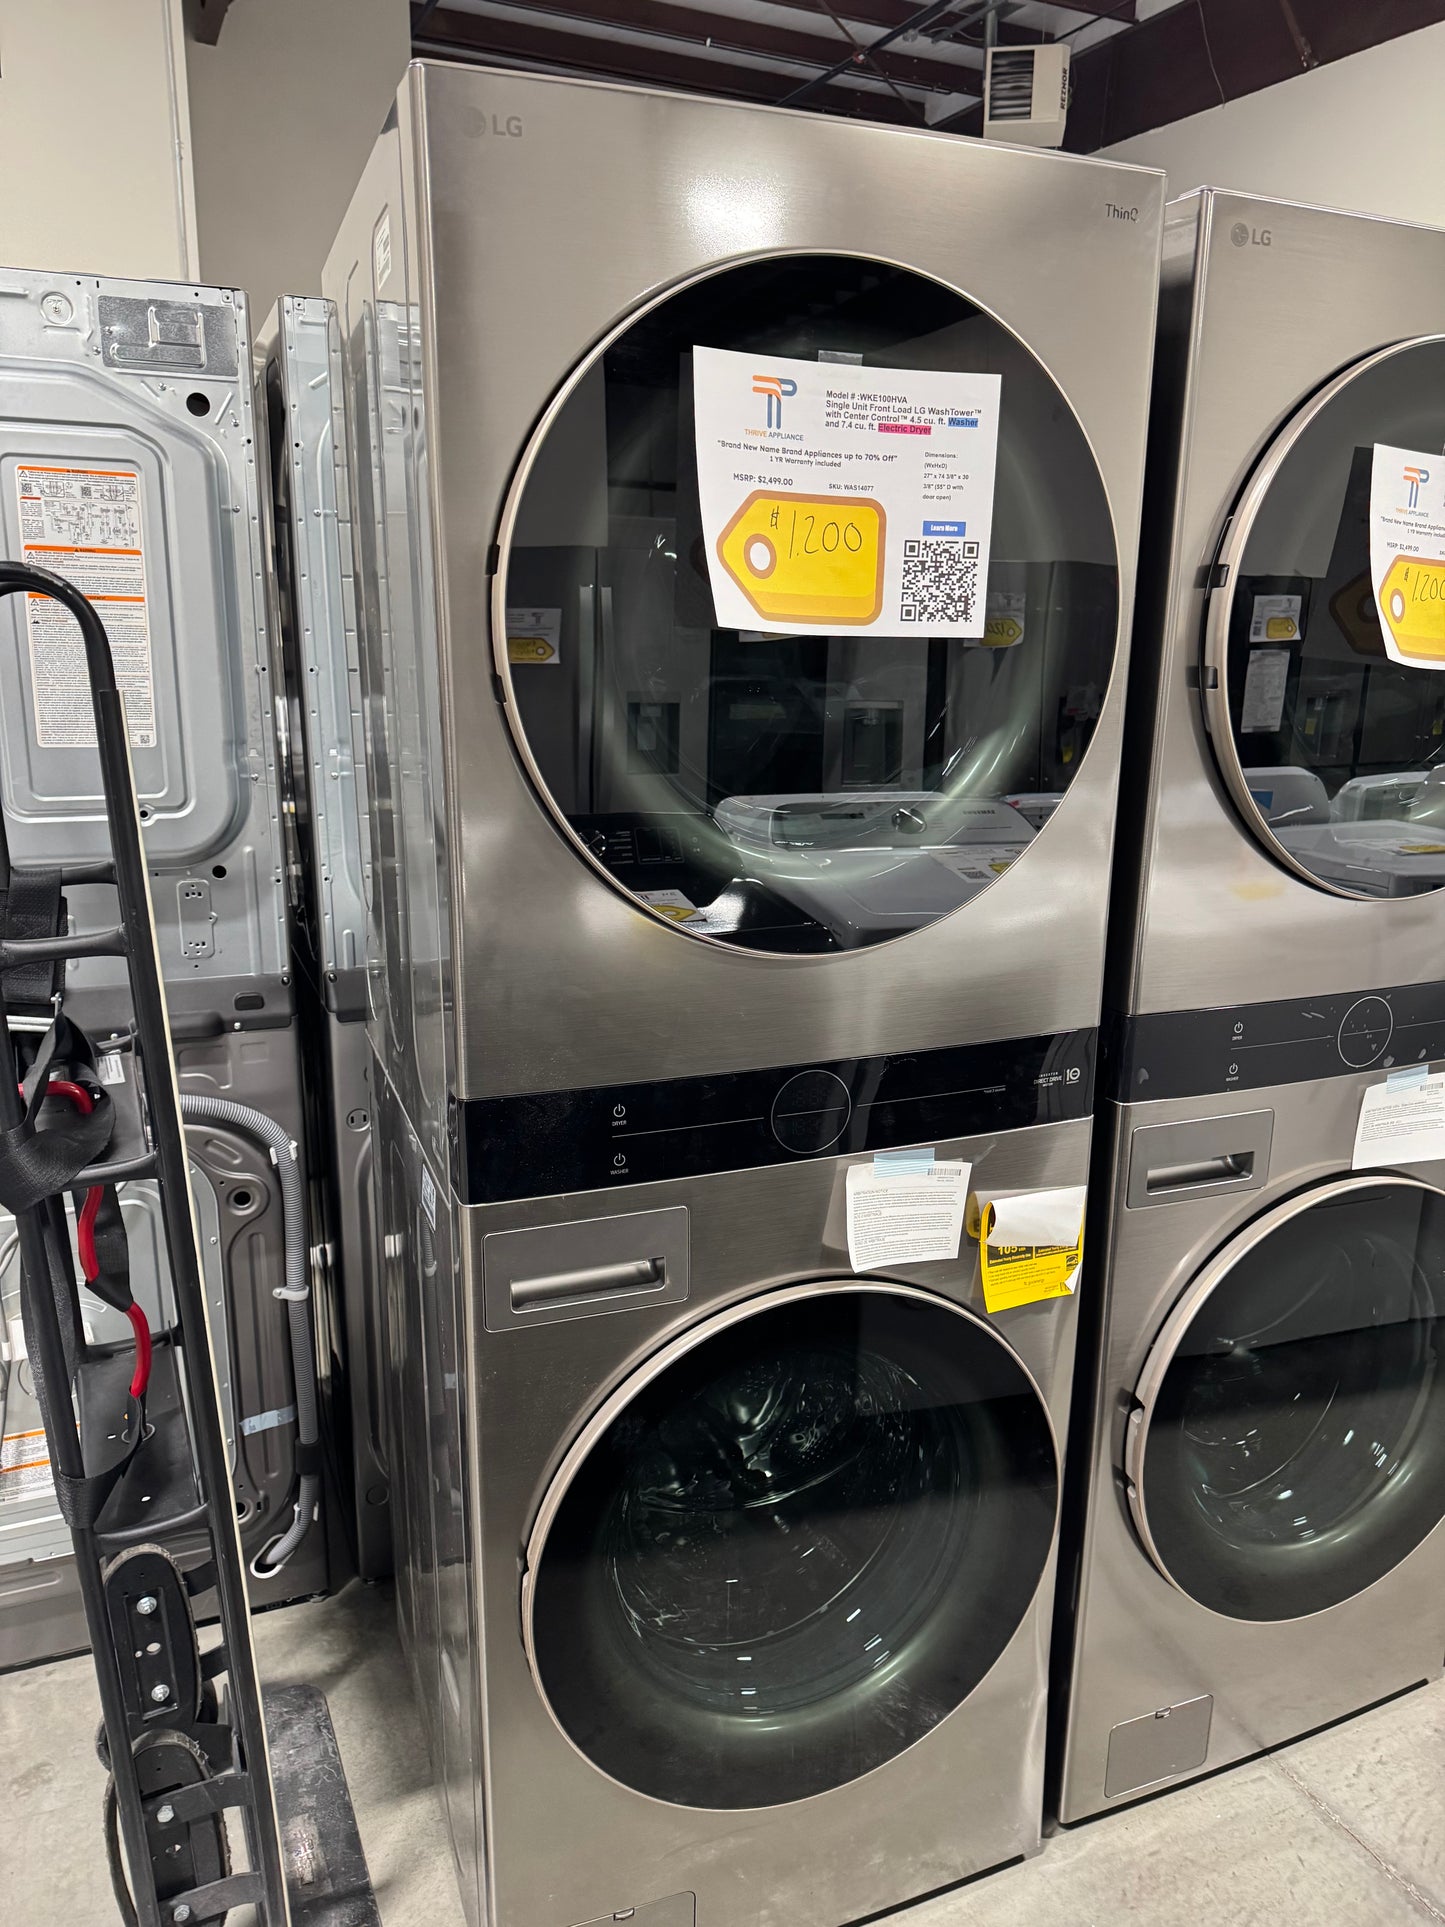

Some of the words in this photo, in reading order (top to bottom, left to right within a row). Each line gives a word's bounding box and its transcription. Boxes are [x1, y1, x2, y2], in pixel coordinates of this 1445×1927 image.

[1060, 68, 1068, 110] REZNOR
[492, 114, 523, 137] LG
[1105, 203, 1139, 222] ThinQ
[1252, 228, 1272, 247] LG
[826, 390, 848, 400] Model
[826, 400, 850, 410] Single
[852, 402, 868, 411] Unit
[869, 404, 891, 413] Front
[892, 405, 912, 414] Load
[914, 406, 926, 414] LG
[825, 410, 841, 418] with
[844, 412, 869, 421] Center
[910, 416, 922, 424] 4.5
[938, 417, 946, 425] ft.
[948, 417, 978, 427] Washer
[744, 428, 768, 437] THRIVE
[768, 431, 804, 441] APPLIANCE
[825, 420, 839, 428] and
[841, 421, 852, 429] 7.4
[868, 423, 876, 431] ft.
[878, 423, 907, 433] Electric
[910, 426, 932, 435] Dryer
[743, 443, 758, 451] New
[760, 445, 780, 453] Name
[782, 447, 802, 456] Brand
[804, 449, 842, 459] Appliances
[864, 453, 880, 461] 70%
[785, 457, 813, 467] Warranty
[815, 459, 842, 468] included
[733, 473, 756, 482] MSRP:
[758, 475, 793, 486] $2,499.00
[1066, 1067, 1080, 1081] 10
